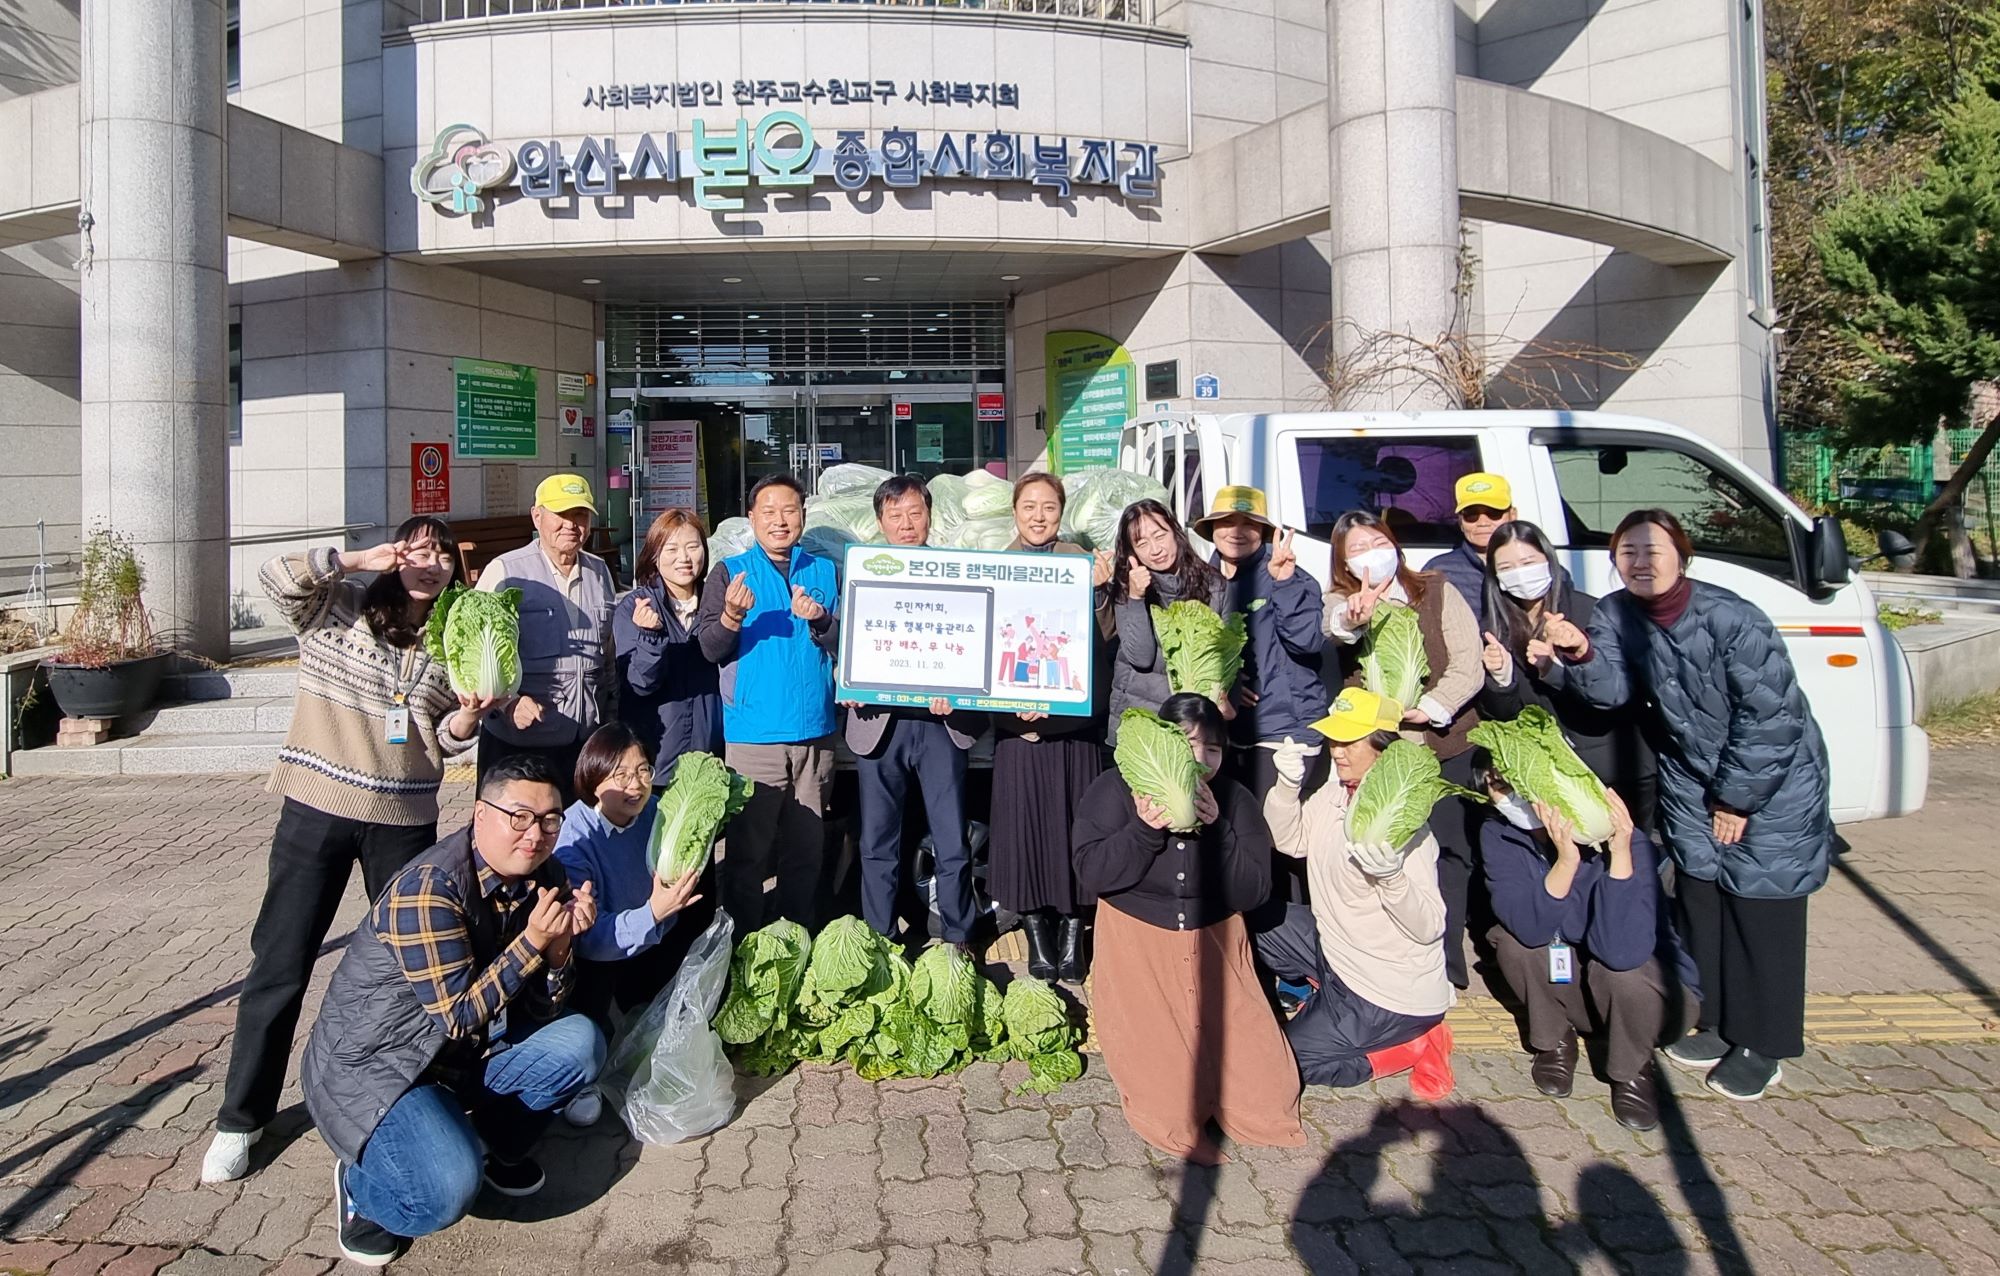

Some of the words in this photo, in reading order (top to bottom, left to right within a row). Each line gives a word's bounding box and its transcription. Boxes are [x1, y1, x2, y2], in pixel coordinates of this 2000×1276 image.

[582, 80, 722, 110] 사회복지법인
[732, 79, 897, 106] 천주교수원교구
[904, 79, 1019, 110] 사회복지회
[517, 130, 678, 197] 안산시
[692, 110, 816, 210] 본오
[832, 125, 1159, 199] 종합사회복지관
[1201, 386, 1213, 397] 39
[416, 479, 446, 491] 대피소
[909, 560, 961, 579] 본오1동
[966, 563, 1075, 585] 행복마을관리소
[894, 601, 948, 614] 주민자치회,
[904, 621, 976, 635] 행복마을관리소
[874, 639, 893, 652] 김장
[899, 640, 922, 652] 배추,
[928, 641, 939, 652] 무
[889, 659, 911, 668] 2023.
